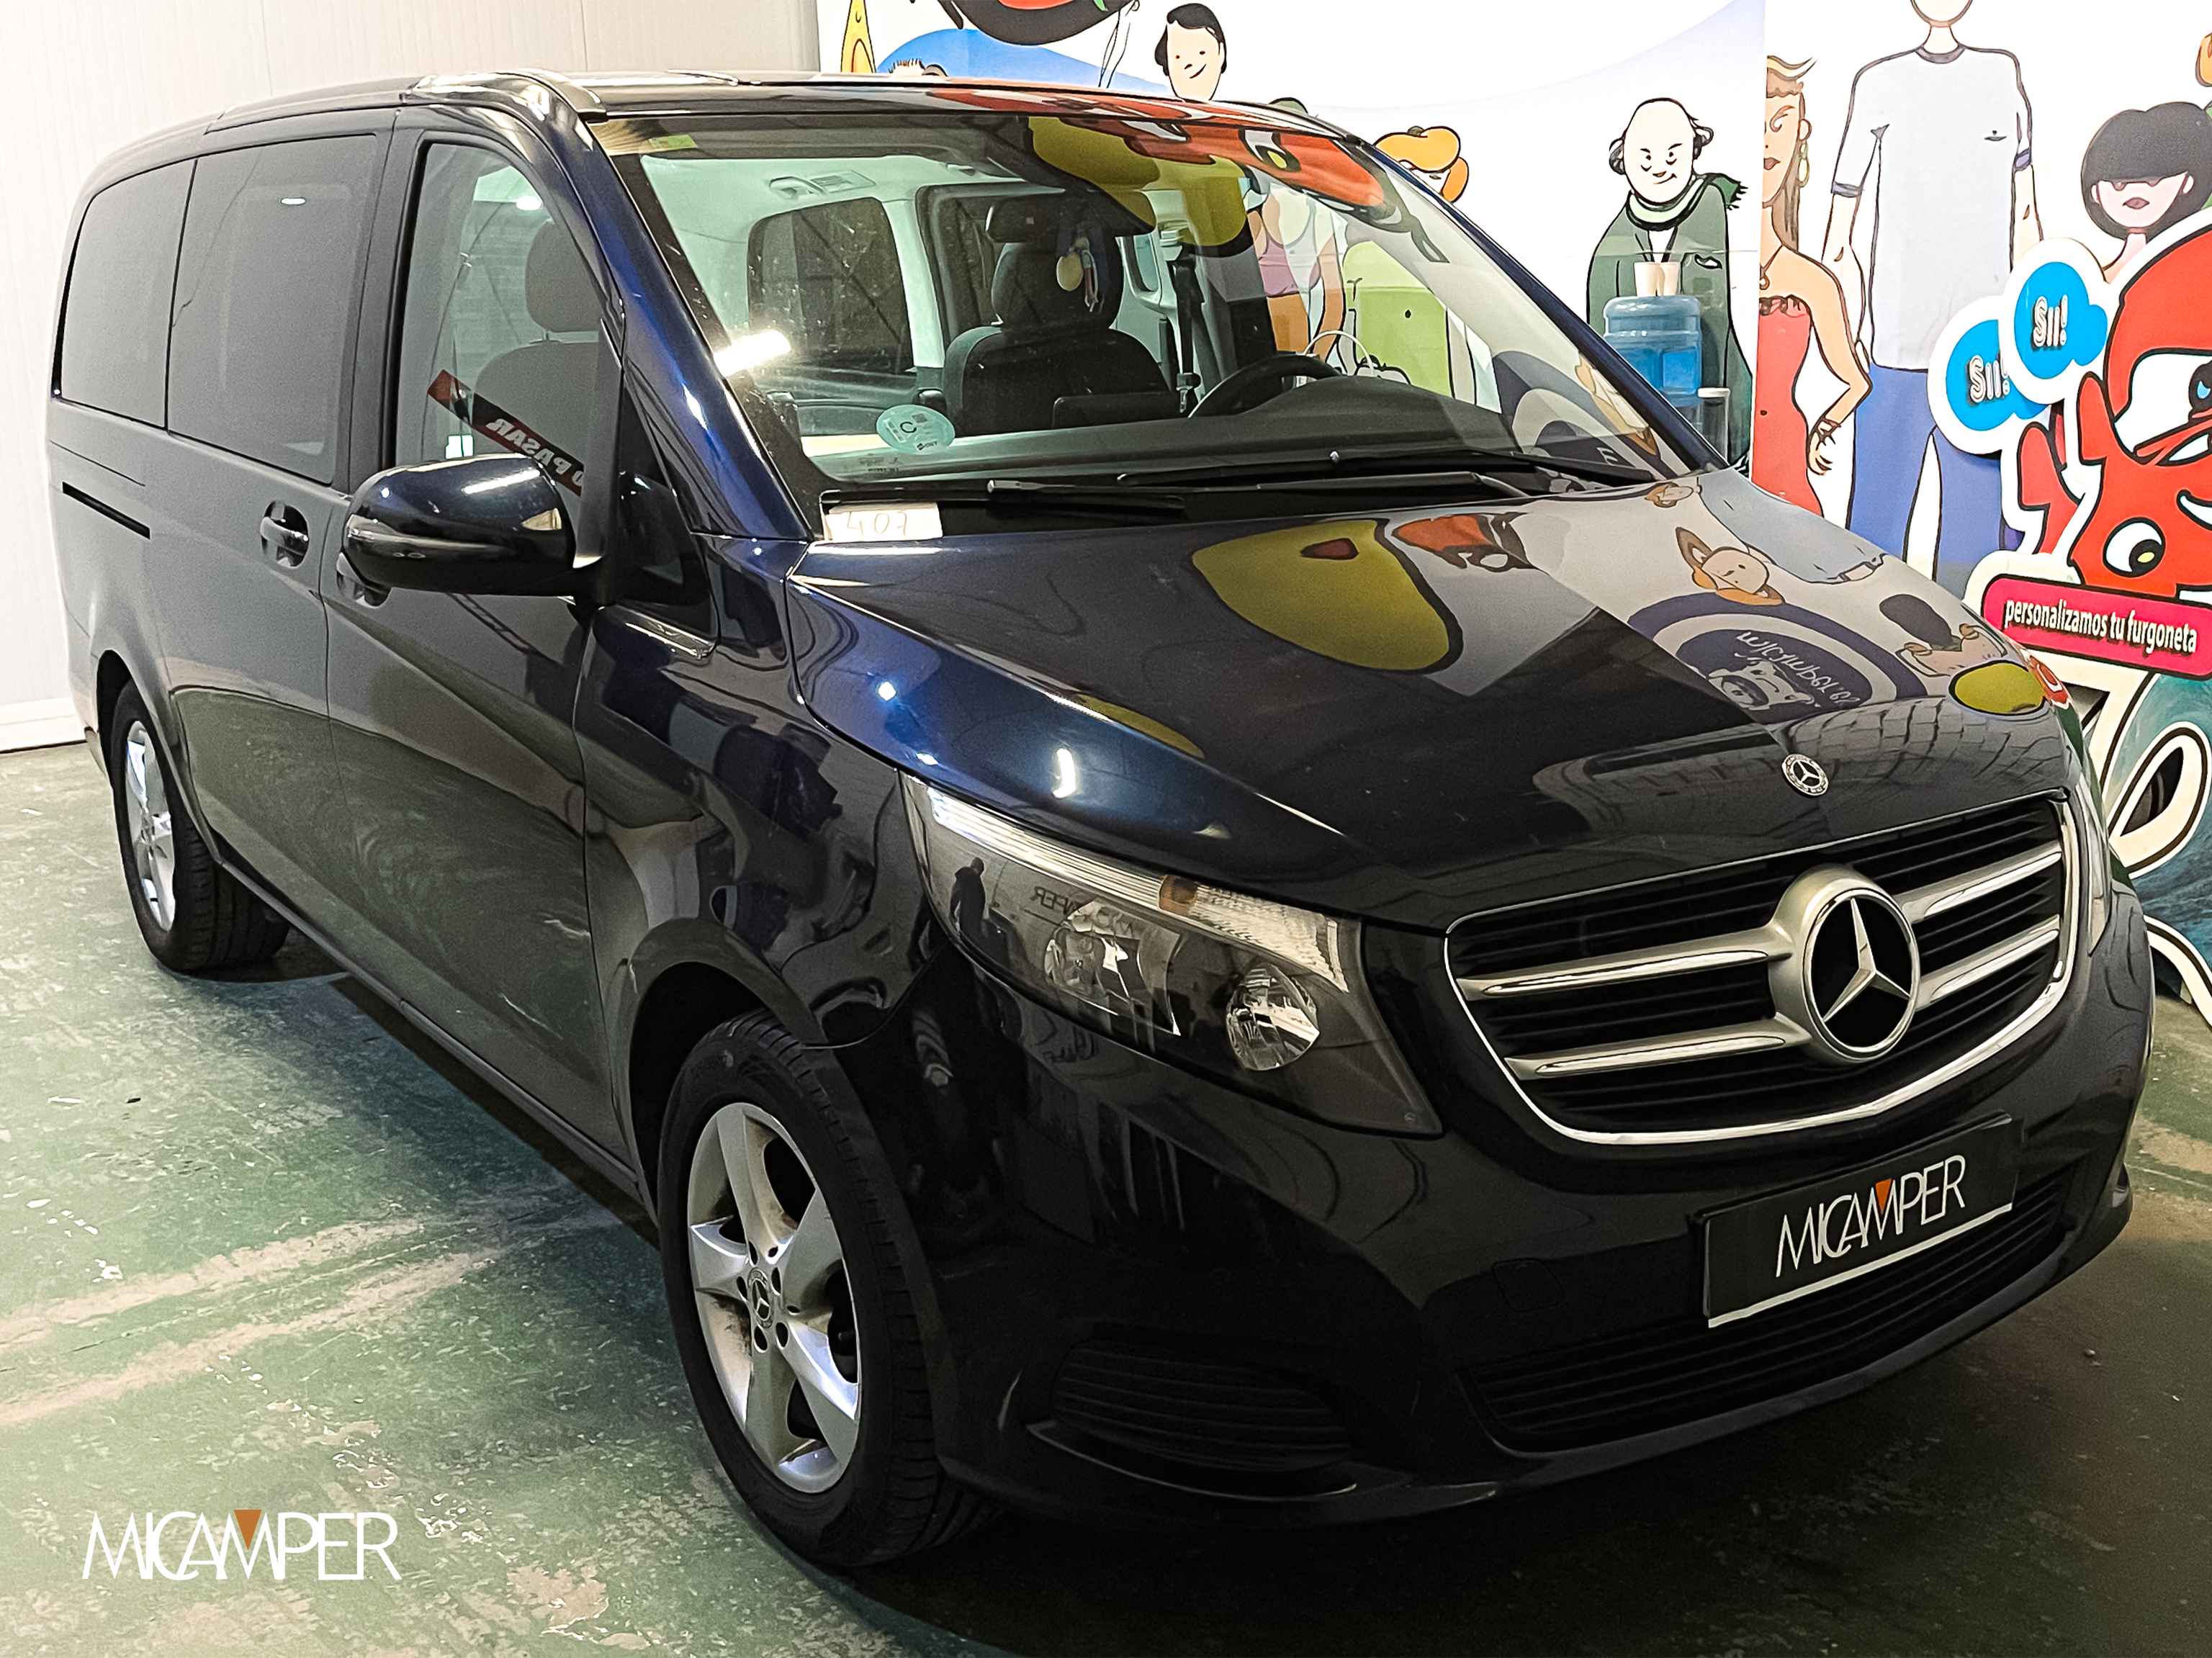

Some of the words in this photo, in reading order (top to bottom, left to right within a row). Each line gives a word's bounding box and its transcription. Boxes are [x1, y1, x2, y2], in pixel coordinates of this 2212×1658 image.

[2004, 598, 2108, 638] personalizamos
[2110, 611, 2126, 640] tu
[2126, 609, 2198, 654] furgoneta
[1775, 1154, 1966, 1278] MICAMPER
